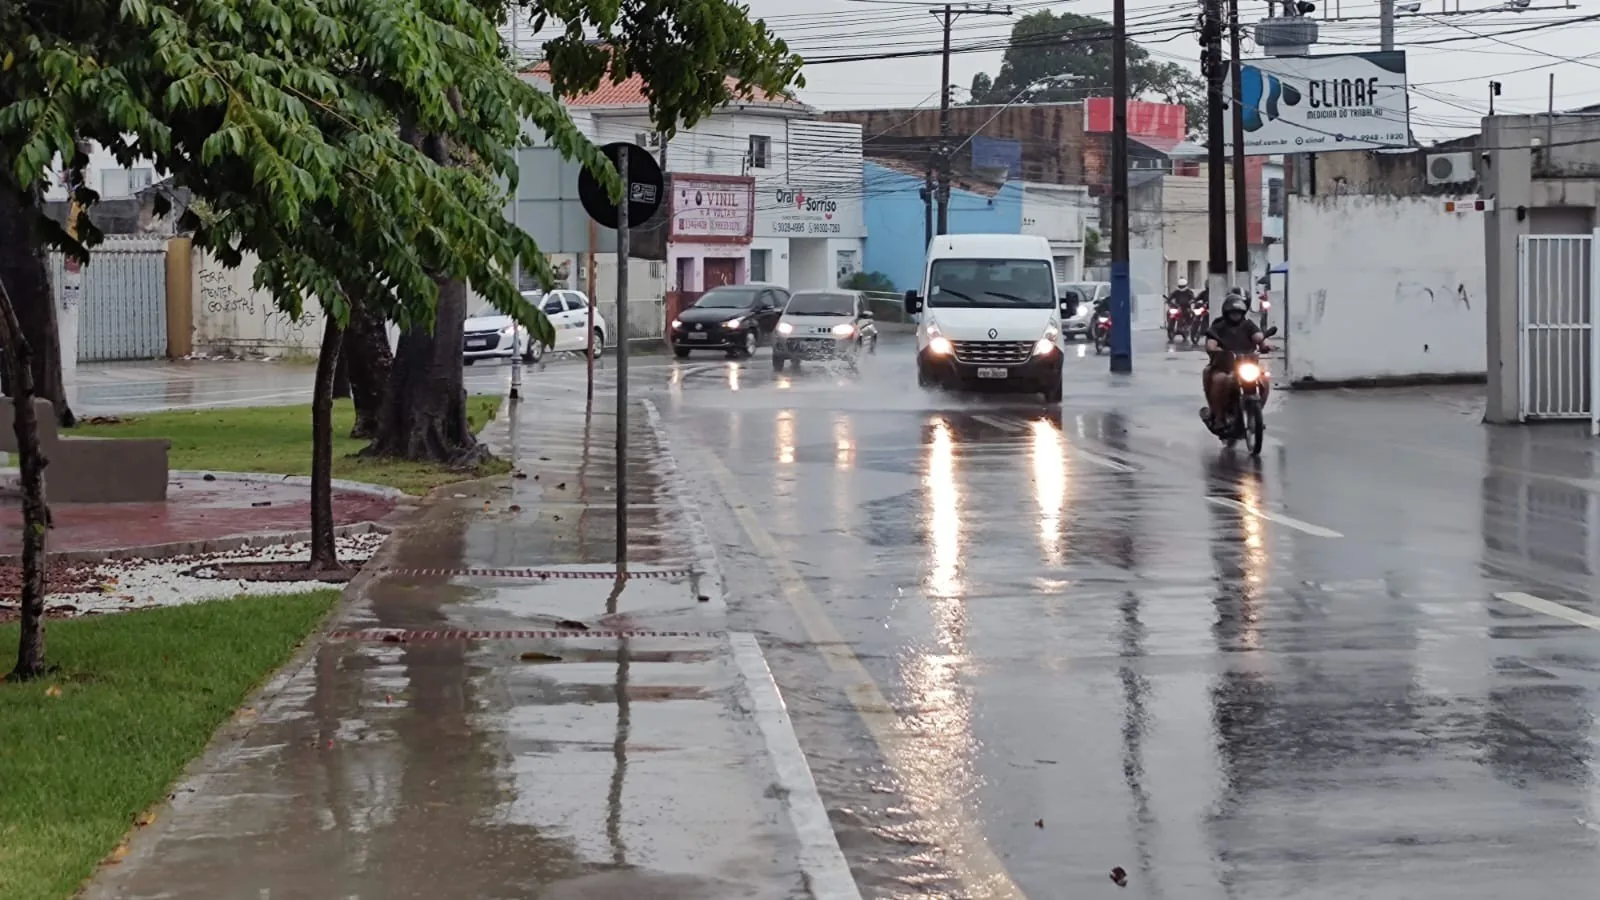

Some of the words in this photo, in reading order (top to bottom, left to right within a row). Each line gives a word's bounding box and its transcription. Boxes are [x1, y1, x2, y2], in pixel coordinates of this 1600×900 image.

[1309, 77, 1378, 108] CLINAF
[1307, 110, 1337, 119] MEDICINA
[1339, 109, 1347, 118] DO
[707, 192, 738, 207] VINIL
[776, 189, 794, 203] Oral
[806, 196, 836, 212] Sorriso
